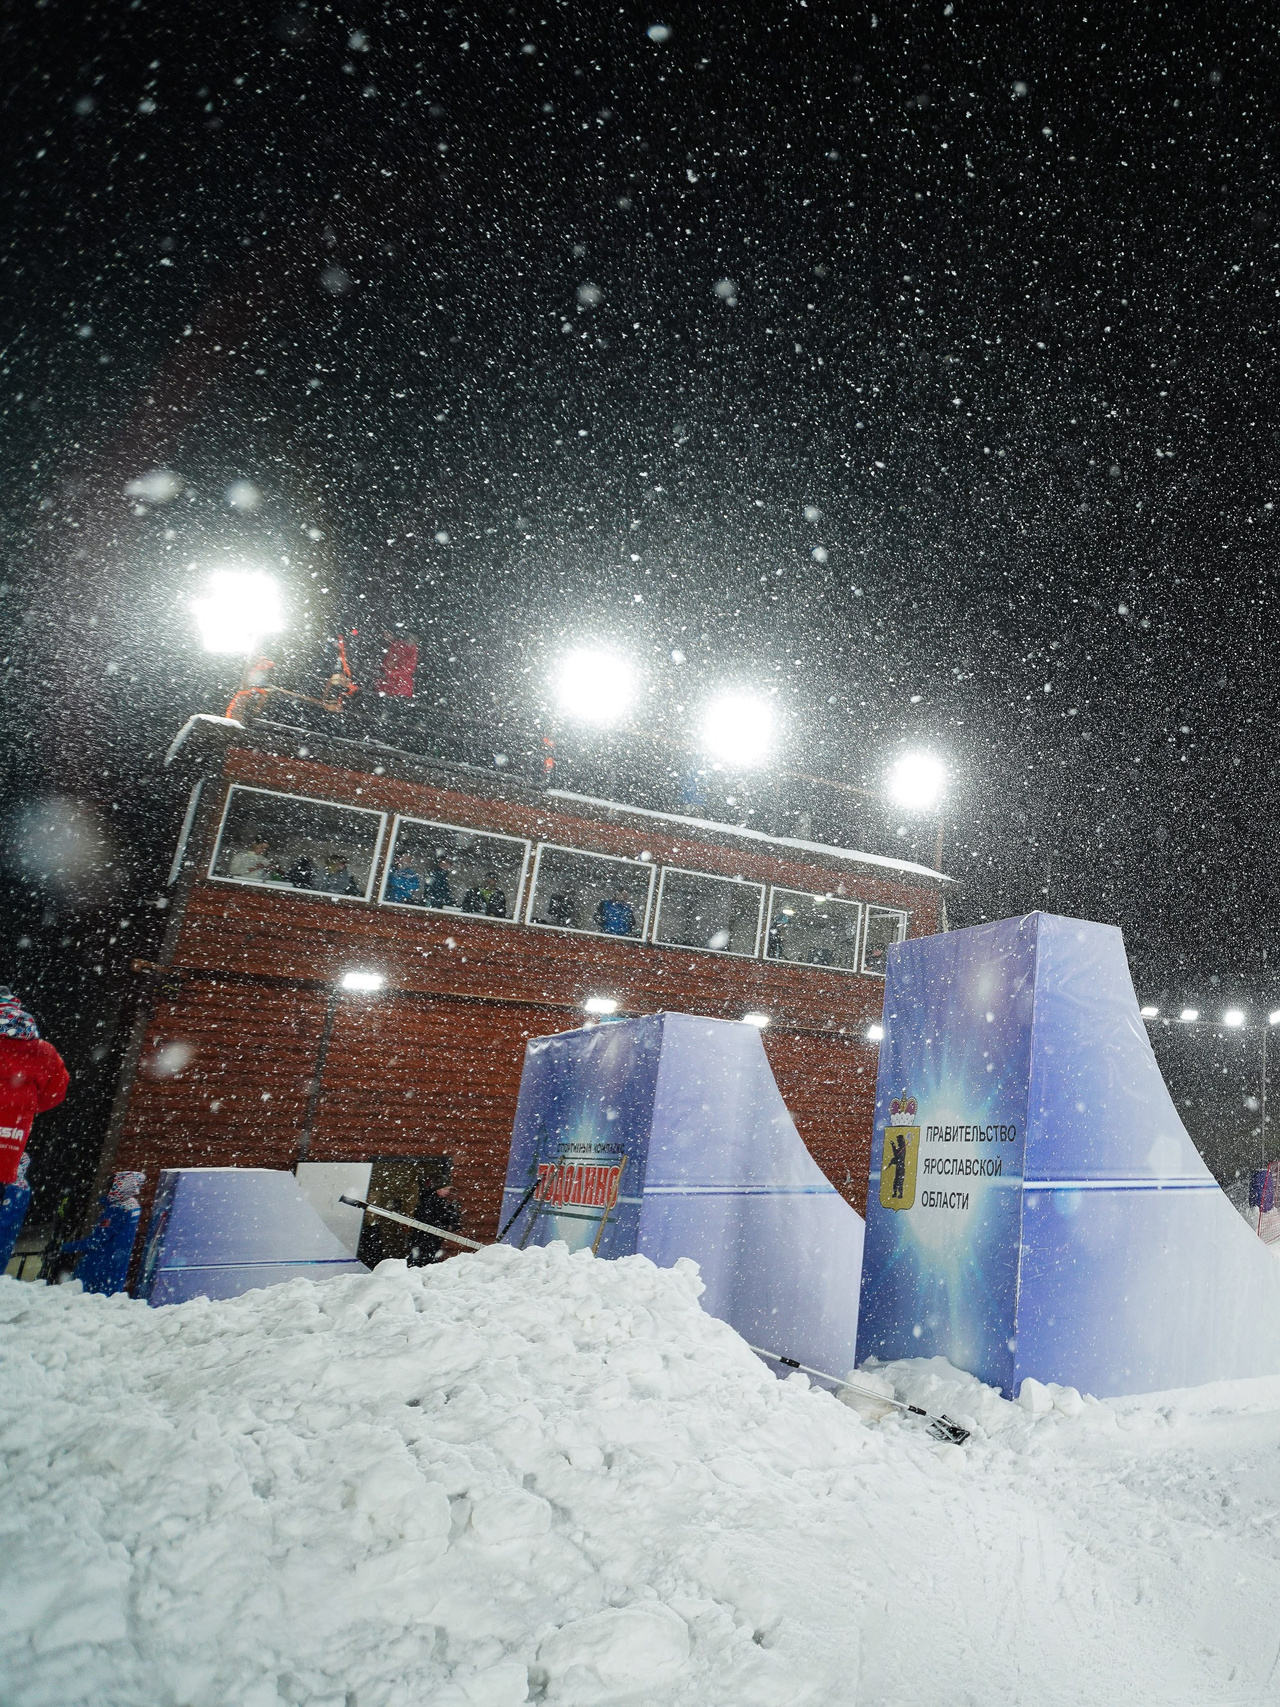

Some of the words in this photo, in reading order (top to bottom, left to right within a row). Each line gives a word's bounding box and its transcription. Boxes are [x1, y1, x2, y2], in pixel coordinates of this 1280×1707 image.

[0, 1126, 24, 1142] SIA
[925, 1125, 1017, 1142] ПРАВИТЕЛЬСТВО
[923, 1155, 1002, 1177] ЯРОСЛАВСКОЙ
[921, 1190, 969, 1210] ОБЛАСТИ
